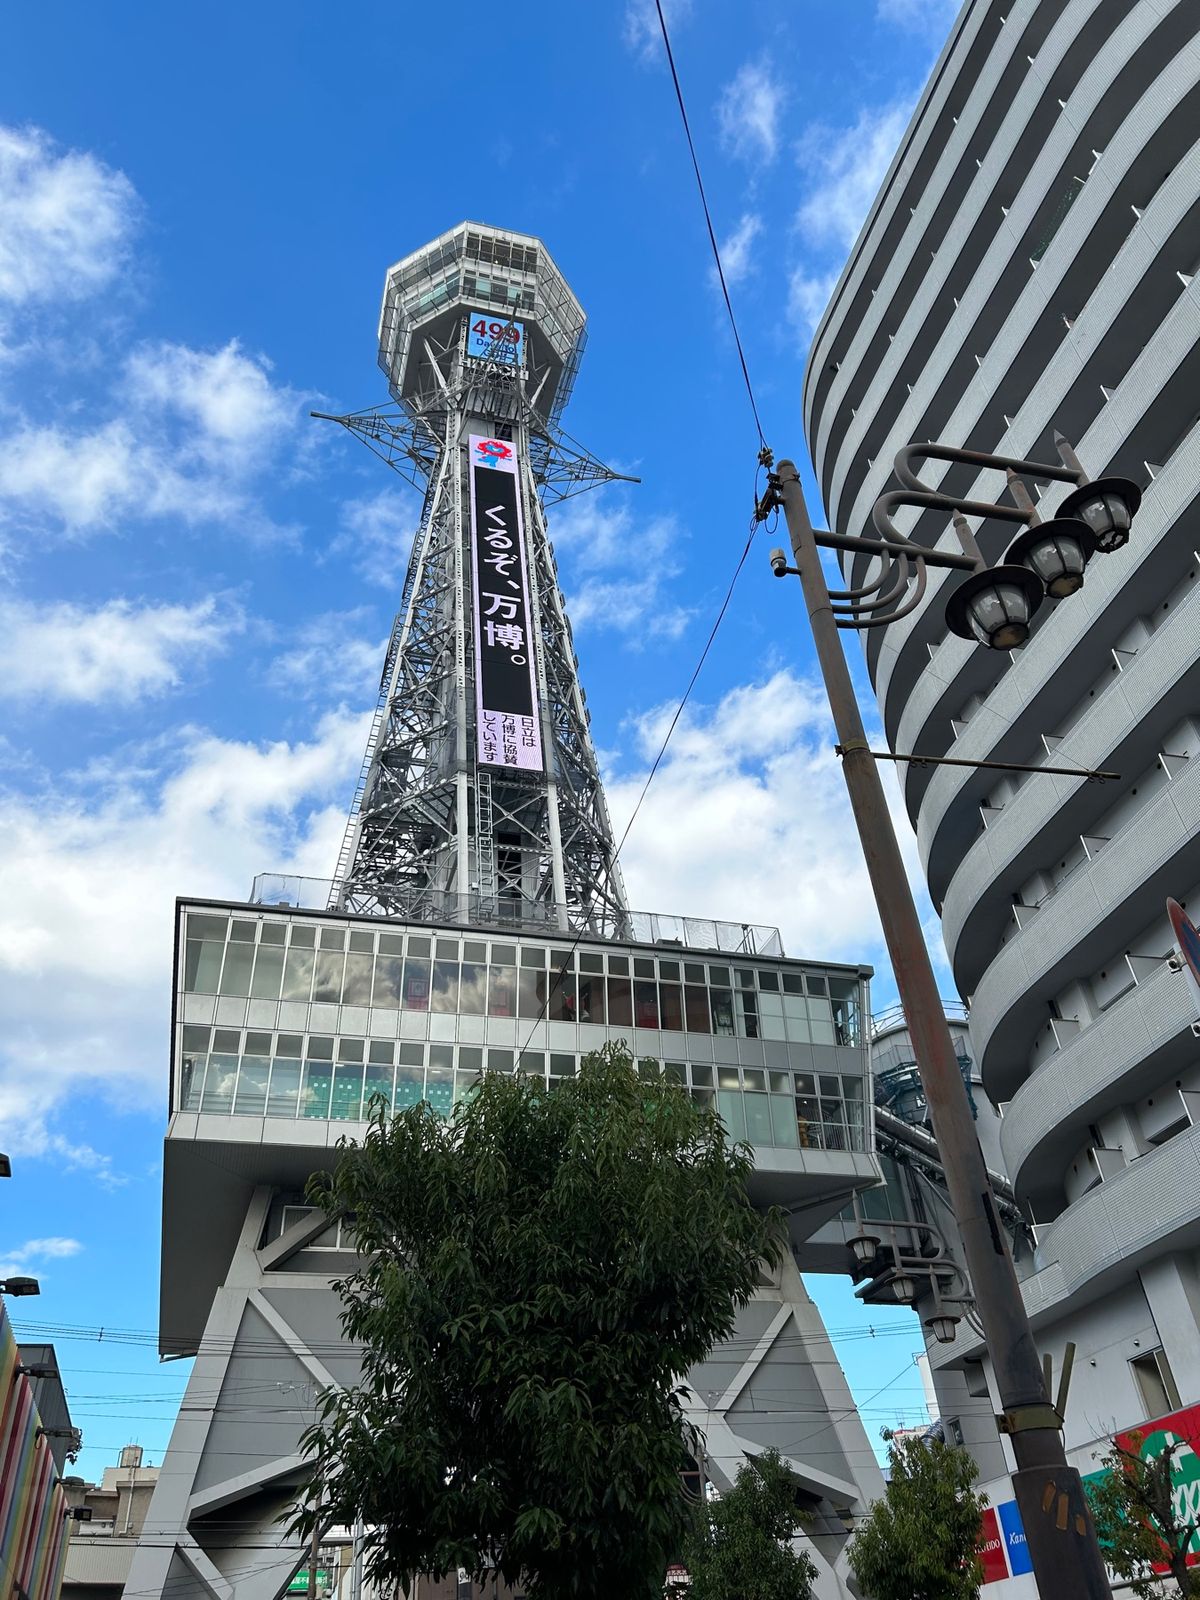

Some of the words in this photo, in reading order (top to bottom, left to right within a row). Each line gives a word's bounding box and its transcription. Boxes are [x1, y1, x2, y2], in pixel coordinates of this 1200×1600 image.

[472, 320, 520, 345] 499
[482, 505, 526, 666] くるぞ、万博。
[483, 711, 498, 762] しています
[501, 714, 518, 766] 万博に協賛
[521, 717, 537, 747] 日立は
